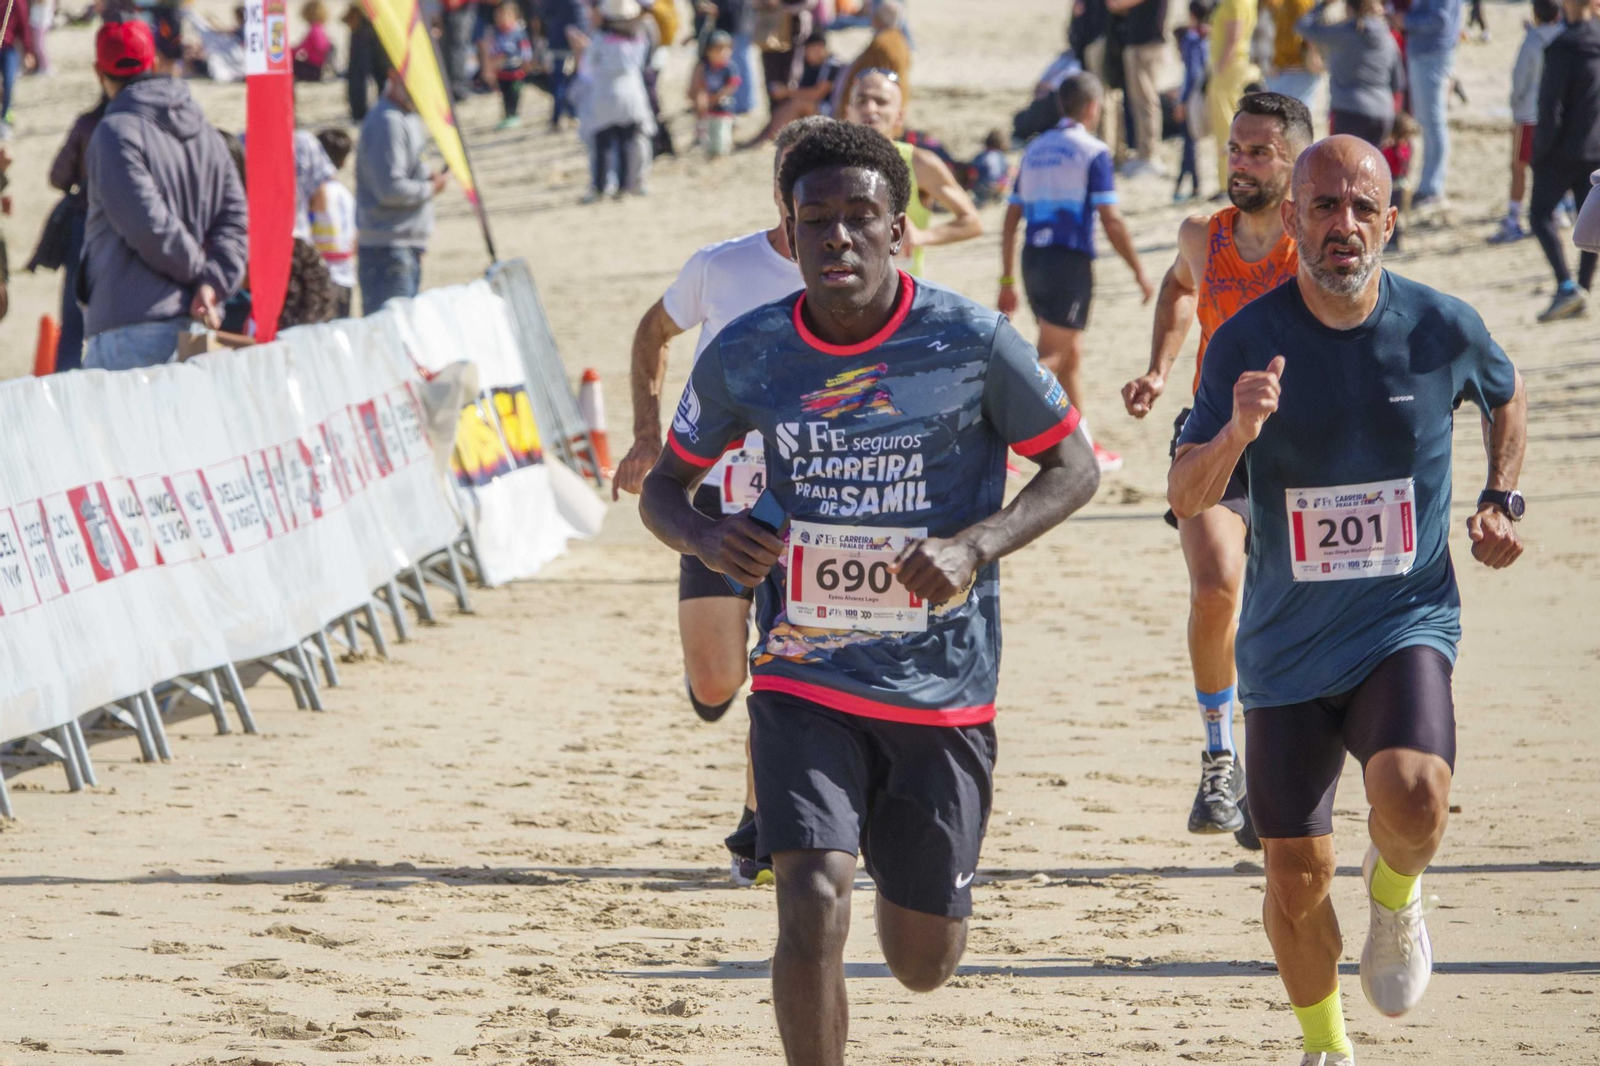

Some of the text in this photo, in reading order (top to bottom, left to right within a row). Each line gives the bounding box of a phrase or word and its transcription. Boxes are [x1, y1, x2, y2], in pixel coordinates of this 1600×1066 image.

[853, 434, 922, 455] seguros
[790, 453, 924, 482] CARREIRA
[795, 482, 838, 500] PRAIA
[819, 480, 932, 516] DE SAMIL
[839, 535, 874, 544] CARREIRA
[1317, 513, 1383, 548] 201
[816, 558, 892, 594] 690
[845, 609, 858, 617] 100
